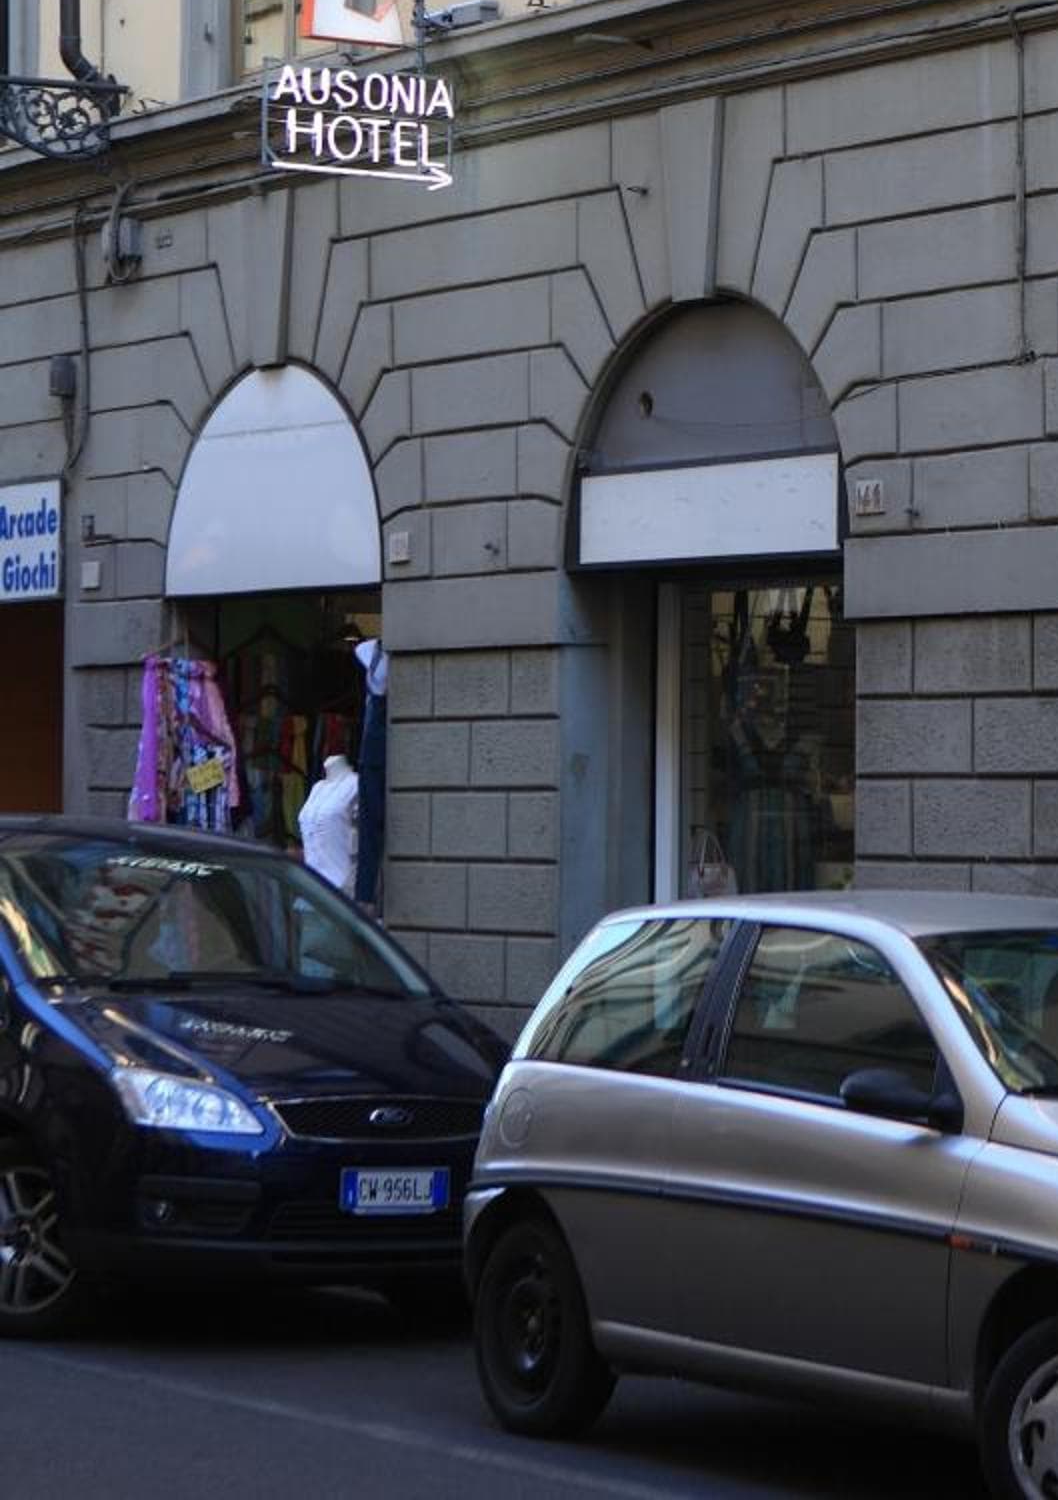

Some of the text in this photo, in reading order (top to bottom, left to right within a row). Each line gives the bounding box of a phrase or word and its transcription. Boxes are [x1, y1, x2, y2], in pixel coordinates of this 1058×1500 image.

[272, 65, 454, 118] AUSONIA
[286, 108, 446, 168] HOTEL
[0, 498, 57, 540] Arcade
[3, 551, 55, 592] Giochi
